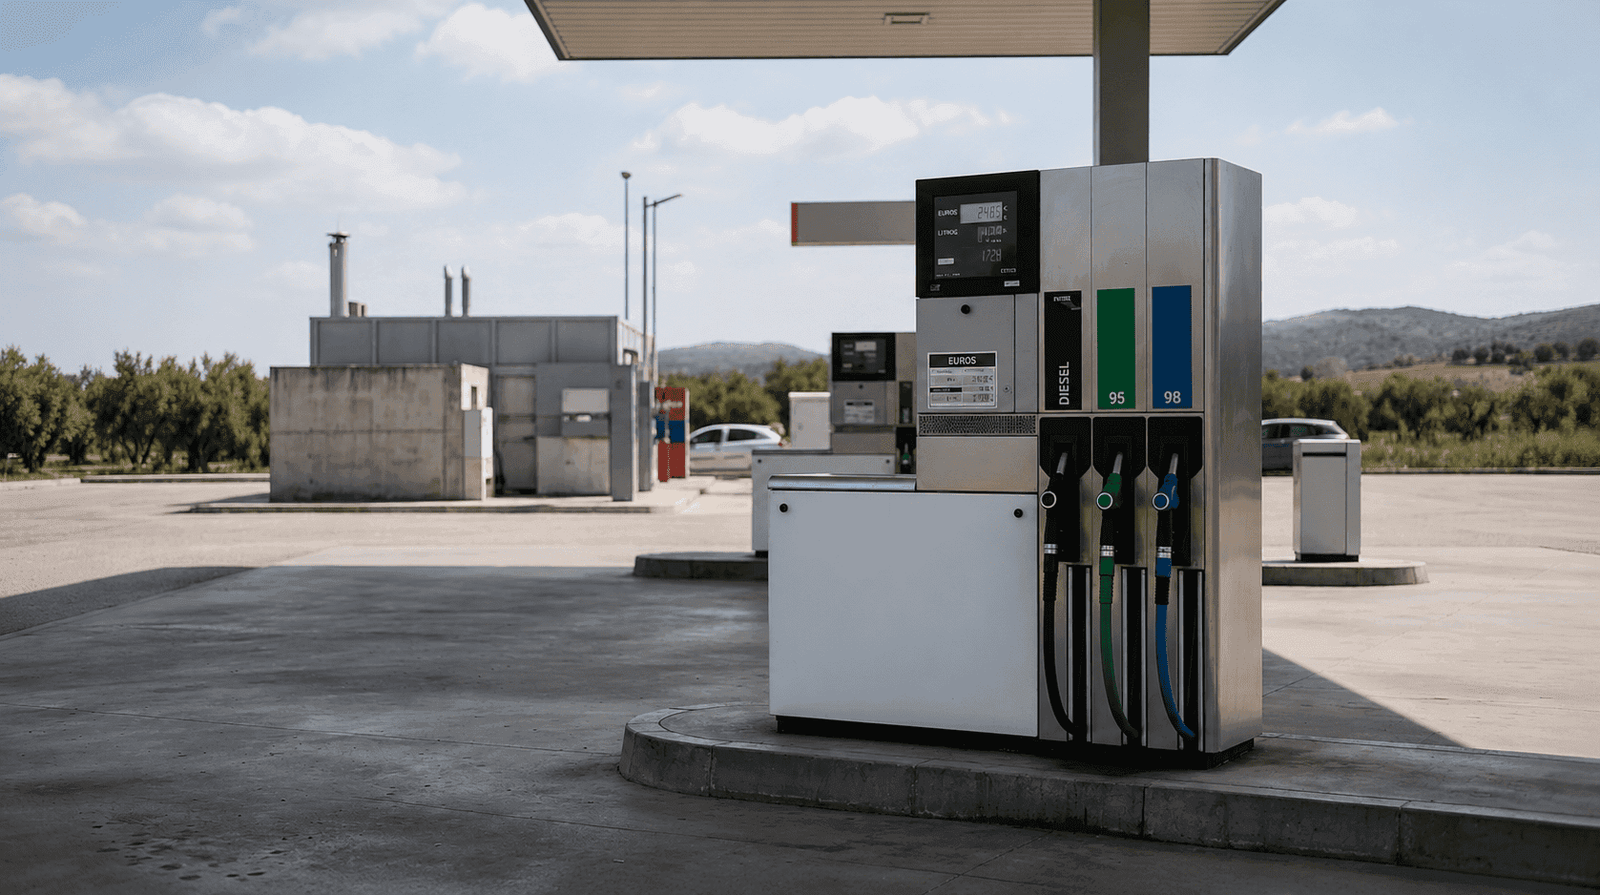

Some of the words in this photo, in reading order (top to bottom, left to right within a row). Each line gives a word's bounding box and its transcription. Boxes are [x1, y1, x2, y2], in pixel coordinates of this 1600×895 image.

[938, 209, 958, 217] EUROS
[948, 356, 977, 365] EUROS
[1059, 361, 1070, 405] DIESEL
[1109, 391, 1125, 405] 95
[1163, 390, 1182, 404] 98
